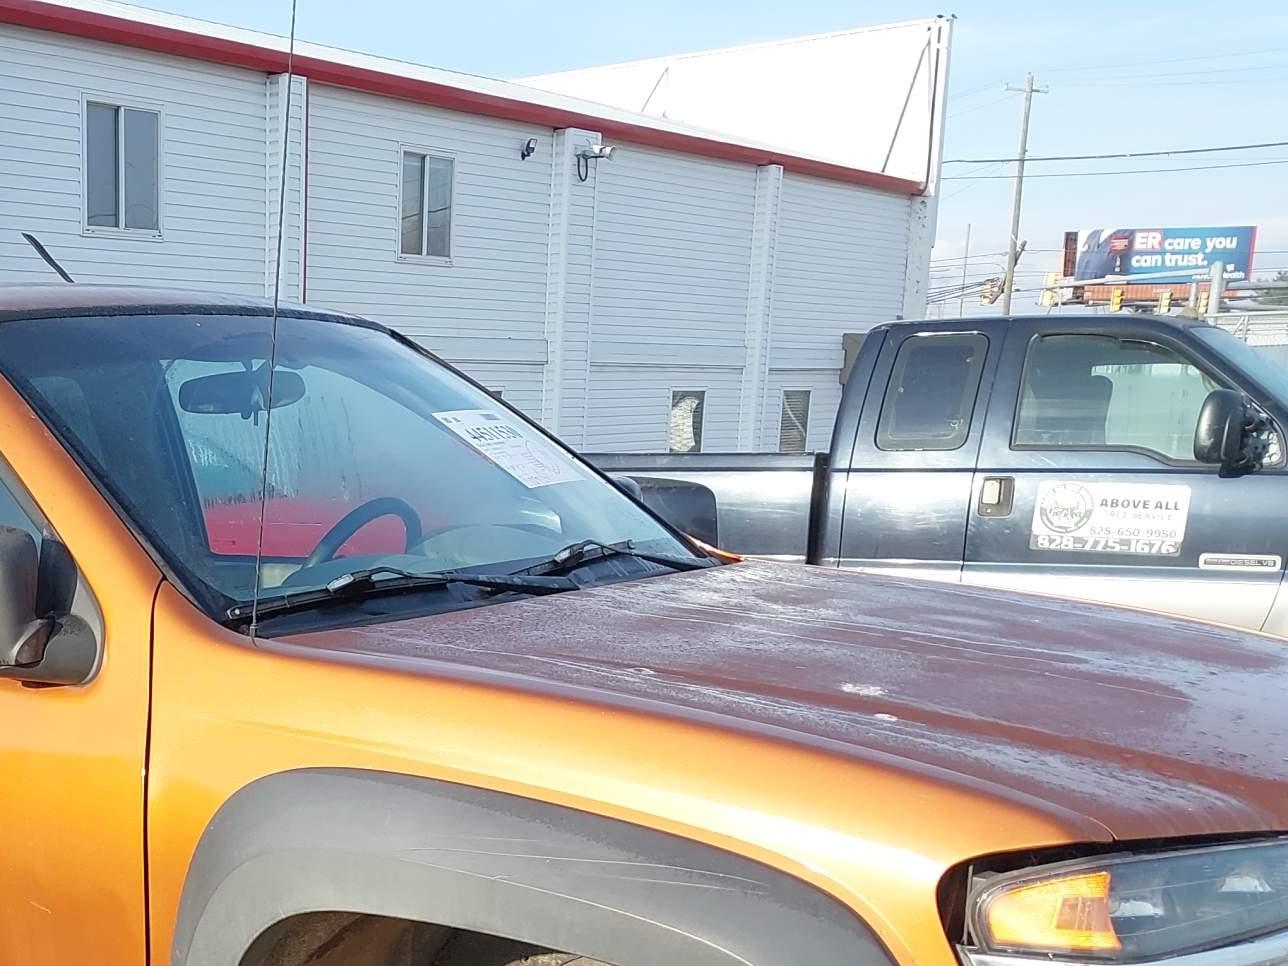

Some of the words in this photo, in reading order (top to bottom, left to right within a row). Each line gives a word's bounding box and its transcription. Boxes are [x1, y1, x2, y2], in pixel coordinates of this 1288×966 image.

[1134, 232, 1161, 250] ER
[1164, 237, 1202, 251] care
[1205, 236, 1238, 254] you
[1131, 254, 1162, 268] can
[1165, 252, 1208, 267] trust.
[1099, 498, 1151, 510] ABOVE
[1154, 501, 1181, 511] ALL
[1038, 535, 1177, 554] 828-775-1676
